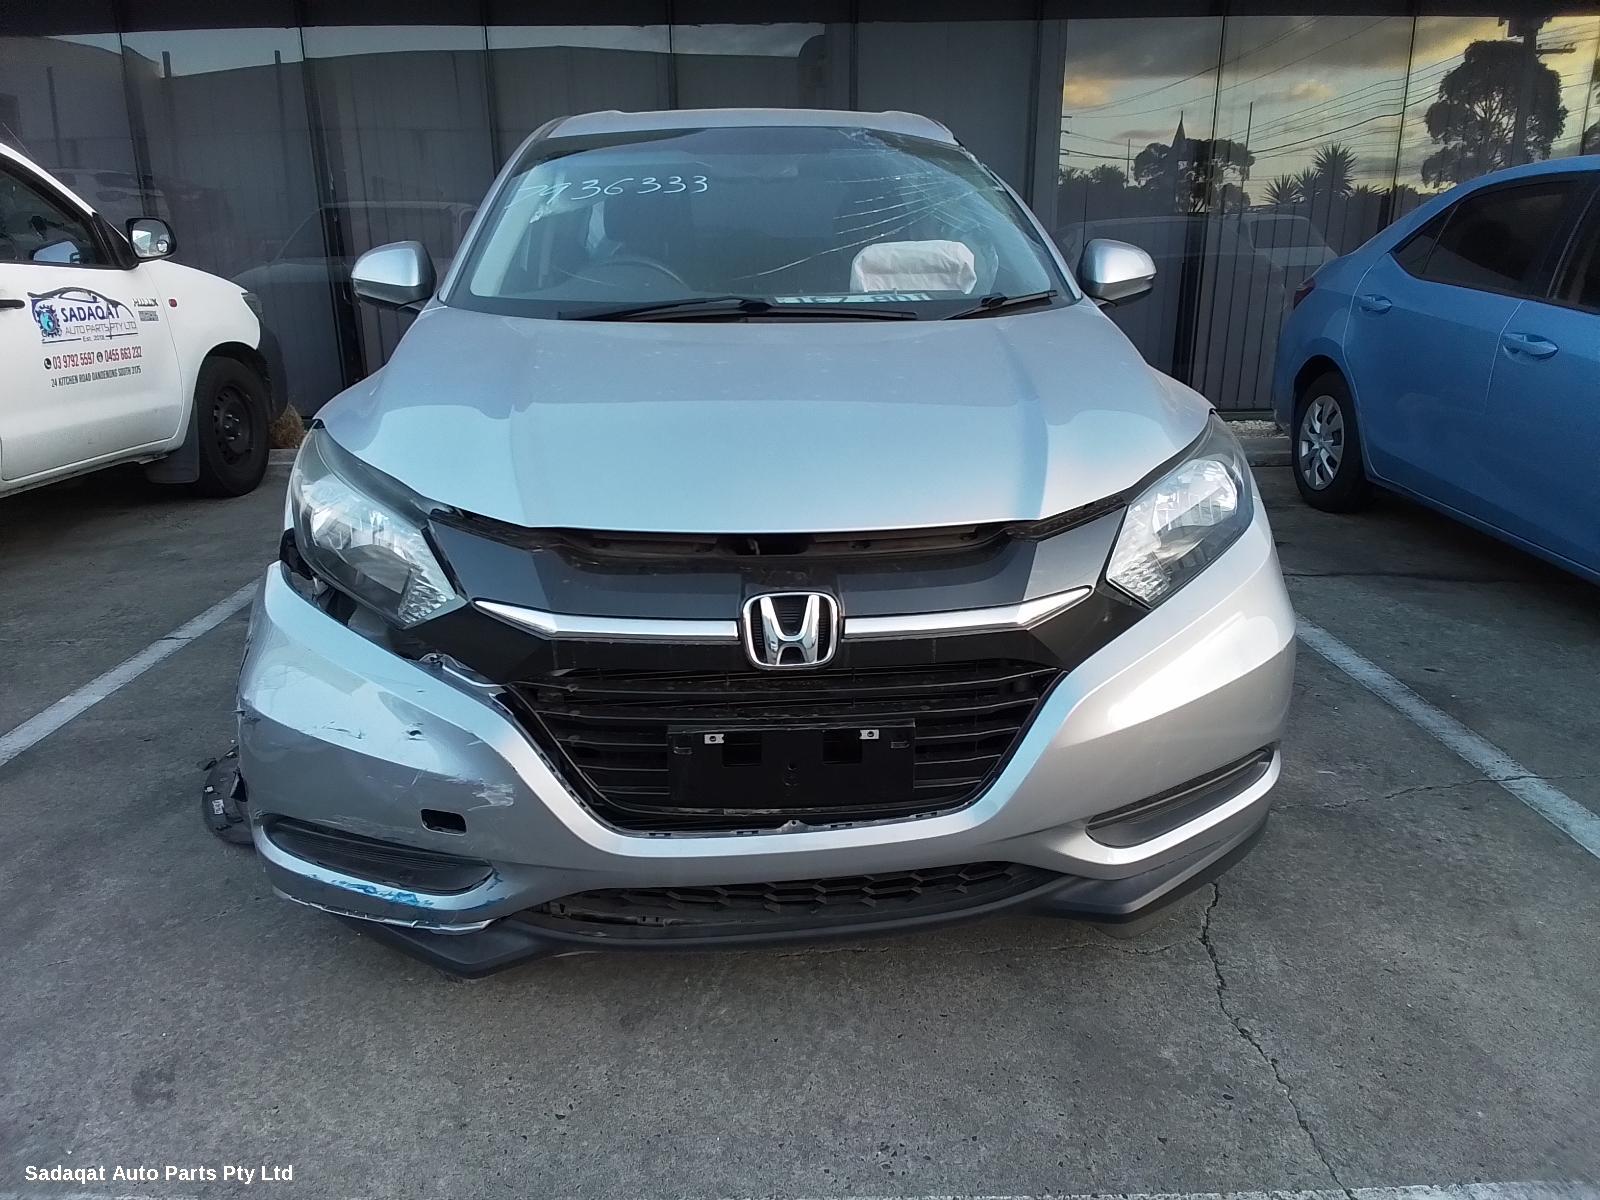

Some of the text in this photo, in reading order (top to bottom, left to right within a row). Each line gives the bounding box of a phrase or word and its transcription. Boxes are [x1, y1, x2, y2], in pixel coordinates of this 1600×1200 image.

[61, 304, 120, 323] SADAQAT
[65, 321, 137, 334] AUTO PARTS PTY LTD
[52, 356, 62, 369] 03
[63, 353, 79, 368] 9792
[80, 351, 95, 366] 5597
[104, 348, 120, 362] 0455
[120, 347, 132, 360] 663
[51, 378, 58, 387] 24
[59, 375, 79, 386] KITCHEN
[79, 372, 92, 383] ROAD
[118, 366, 131, 377] SOUTH
